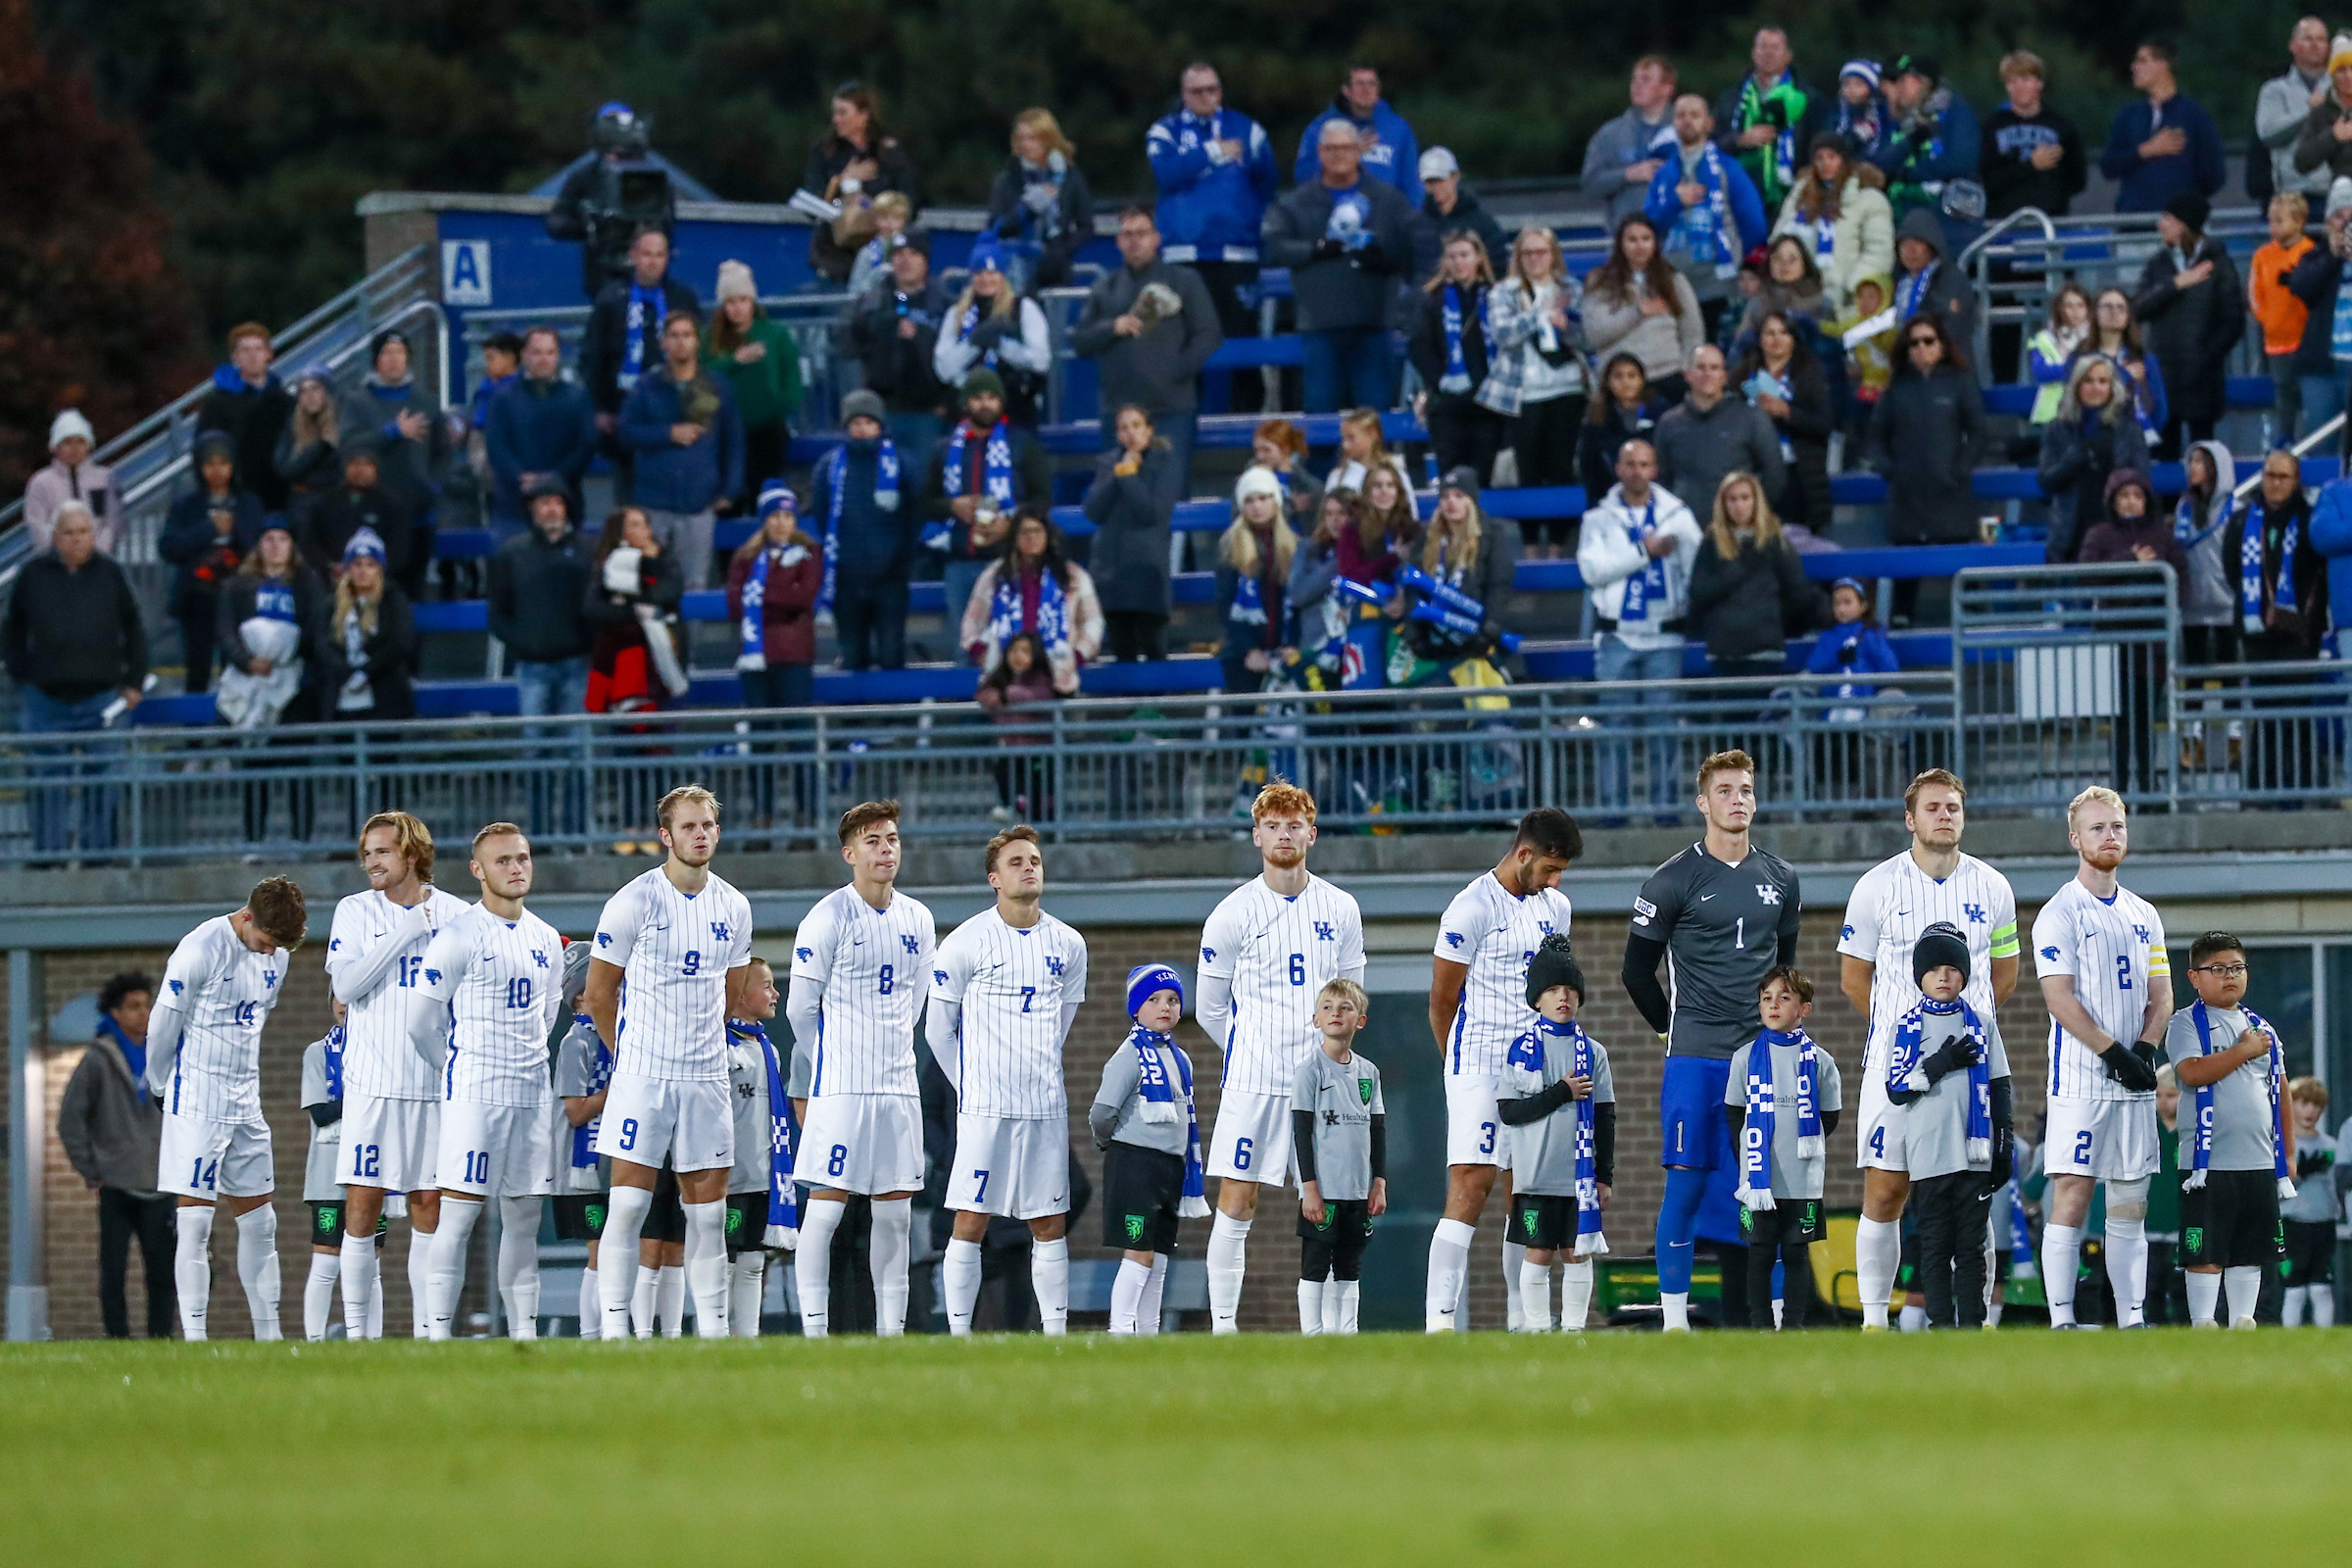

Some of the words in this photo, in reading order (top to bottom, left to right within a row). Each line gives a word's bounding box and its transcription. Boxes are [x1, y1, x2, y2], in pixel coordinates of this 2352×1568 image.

[453, 246, 481, 289] A
[1754, 885, 1780, 906] UK
[1963, 904, 1986, 924] UK
[710, 922, 729, 941] UK
[901, 934, 919, 955] UK
[1314, 921, 1335, 942] UK
[1736, 916, 1744, 950] 1
[2132, 924, 2150, 944] UK
[531, 950, 550, 968] UK
[682, 951, 700, 975] 9
[1045, 956, 1065, 977] UK
[1289, 954, 1304, 986] 6
[2117, 956, 2132, 989] 2
[264, 970, 277, 989] UK
[507, 978, 531, 1008] 10
[879, 964, 894, 995] 8
[235, 1000, 258, 1026] 14
[1021, 986, 1036, 1013] 7
[1321, 1109, 1340, 1126] UK
[620, 1118, 638, 1151] 9
[1480, 1122, 1497, 1153] 3
[1676, 1120, 1684, 1152] 1
[1870, 1126, 1885, 1158] 4
[2074, 1131, 2092, 1164] 2
[354, 1144, 380, 1177] 12
[464, 1150, 490, 1184] 10
[828, 1145, 847, 1176] 8
[1234, 1138, 1252, 1170] 6
[190, 1156, 219, 1191] 14
[973, 1170, 990, 1203] 7
